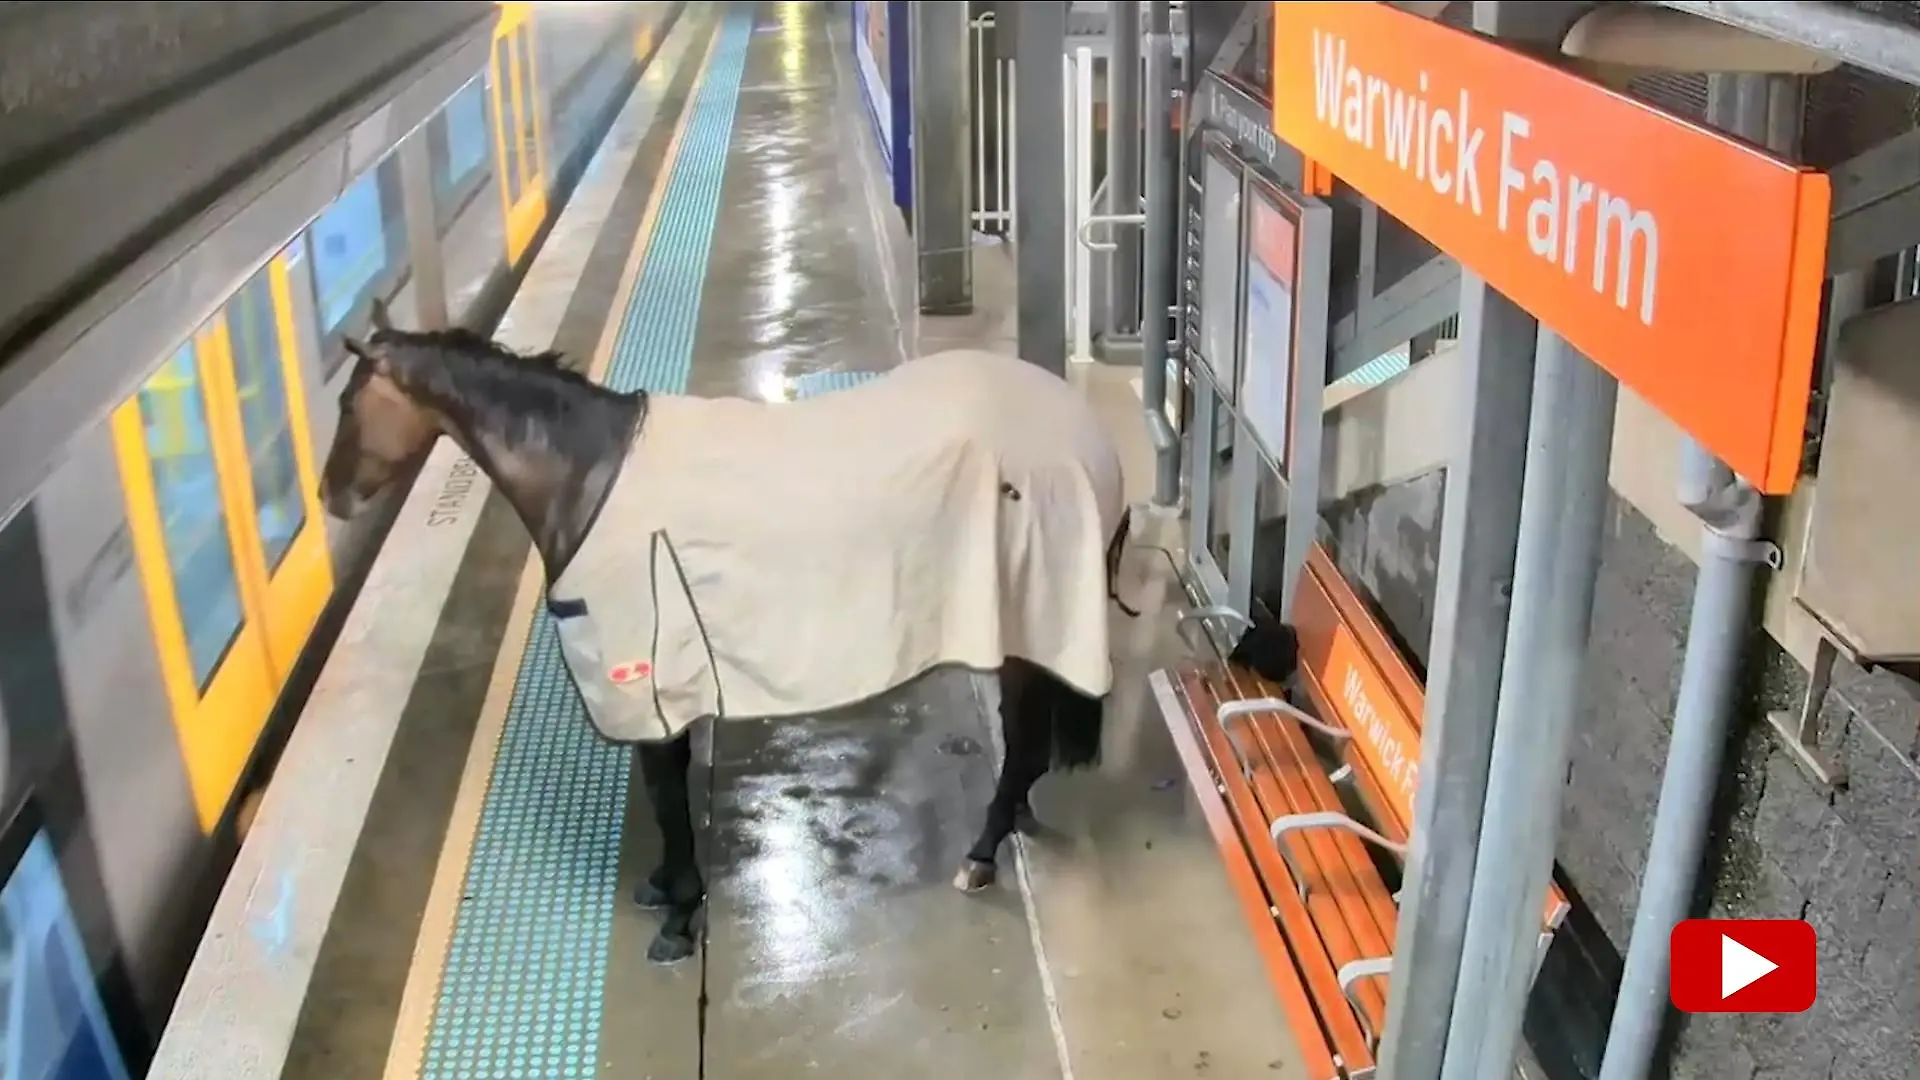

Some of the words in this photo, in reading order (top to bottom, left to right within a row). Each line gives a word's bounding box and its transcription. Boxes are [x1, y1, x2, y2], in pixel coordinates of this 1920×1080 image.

[1313, 28, 1485, 216] Warwick
[1497, 111, 1659, 325] Farm
[426, 480, 473, 527] STAND
[1344, 664, 1404, 782] Warwick
